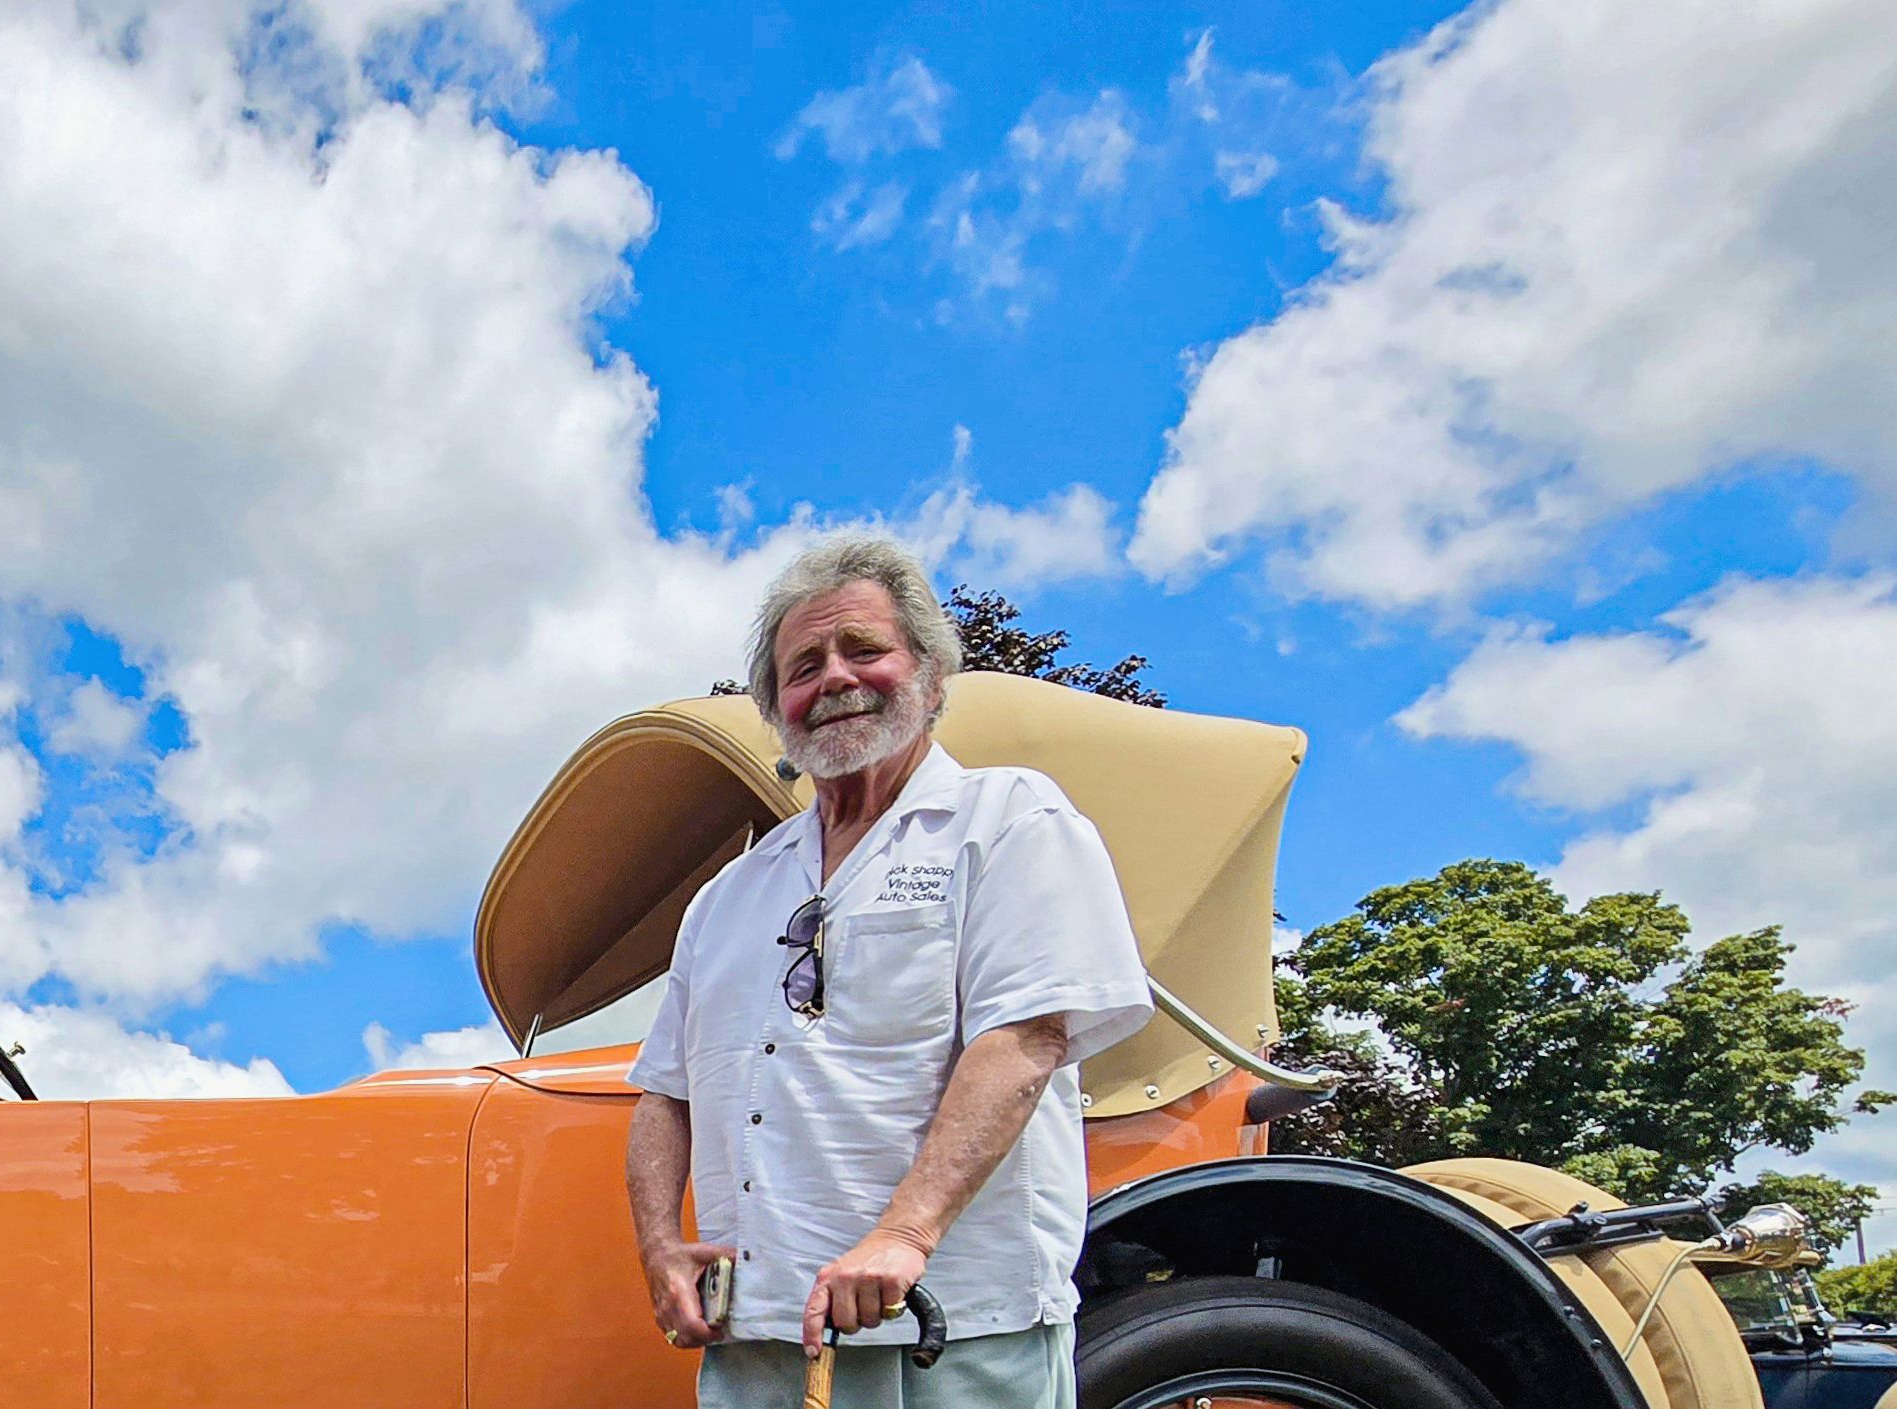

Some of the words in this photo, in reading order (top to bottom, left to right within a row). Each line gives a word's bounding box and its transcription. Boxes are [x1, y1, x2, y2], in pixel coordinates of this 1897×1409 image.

[885, 864, 908, 879] ick
[888, 878, 940, 891] Vintage
[875, 892, 907, 903] Auto
